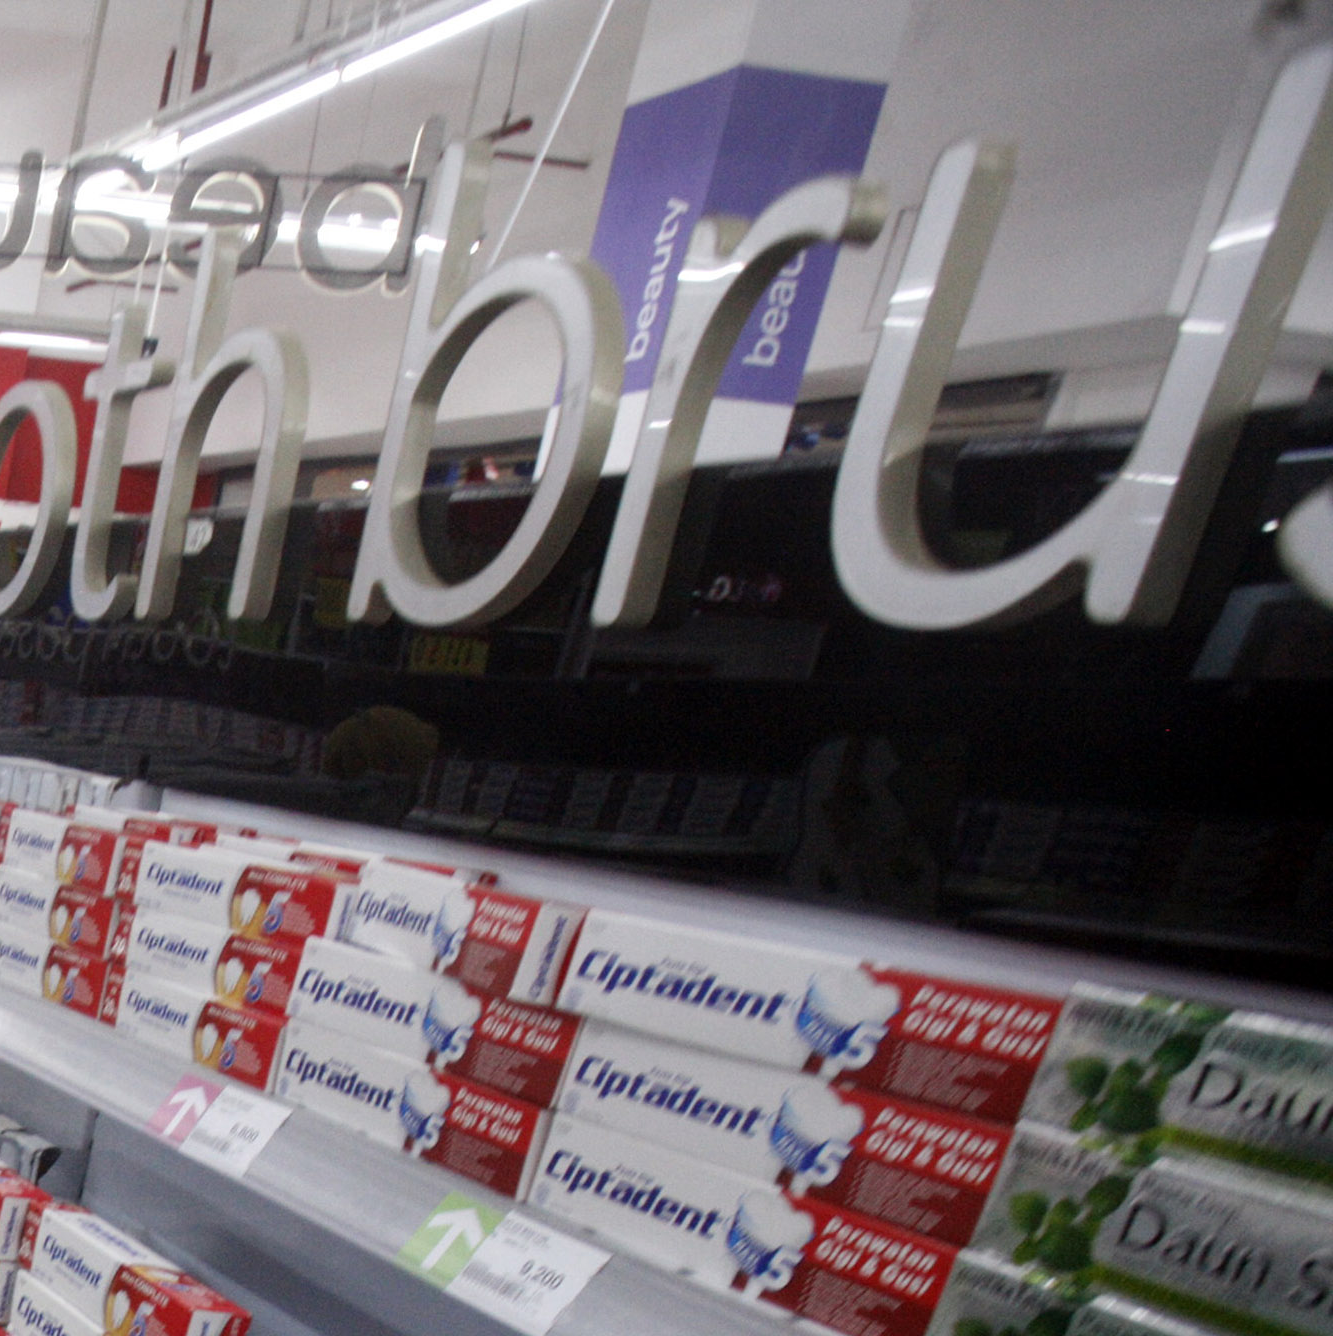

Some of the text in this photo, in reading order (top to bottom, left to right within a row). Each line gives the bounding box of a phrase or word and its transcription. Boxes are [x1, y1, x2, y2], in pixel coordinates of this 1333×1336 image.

[623, 197, 690, 364] beauty
[742, 249, 808, 368] beau
[13, 827, 55, 851] Ciptadent
[0, 884, 45, 910] Ciptadent
[147, 862, 224, 896] Ciptadent
[356, 891, 434, 935] Ciptadent
[137, 927, 209, 962] Ciptadent
[127, 989, 190, 1027] Ciptadent
[299, 968, 419, 1027] Ciptadent
[577, 948, 788, 1022] Ciptadent
[909, 984, 1051, 1031] Perawatan
[902, 1008, 956, 1043] Gigi
[957, 1020, 980, 1044] &
[981, 1025, 1049, 1061] Gusi
[285, 1048, 394, 1112] Ciptadent
[574, 1055, 766, 1138] Ciptadent
[864, 1128, 995, 1185] Gigi & Gusi
[873, 1106, 998, 1159] Perawatan
[545, 1149, 726, 1240] Ciptadent
[42, 1234, 104, 1288] Ciptadent
[814, 1238, 935, 1298] Gigi & Gusi
[821, 1215, 938, 1273] Perawatan
[1118, 1199, 1273, 1293] Daun
[518, 1258, 565, 1295] 9,200
